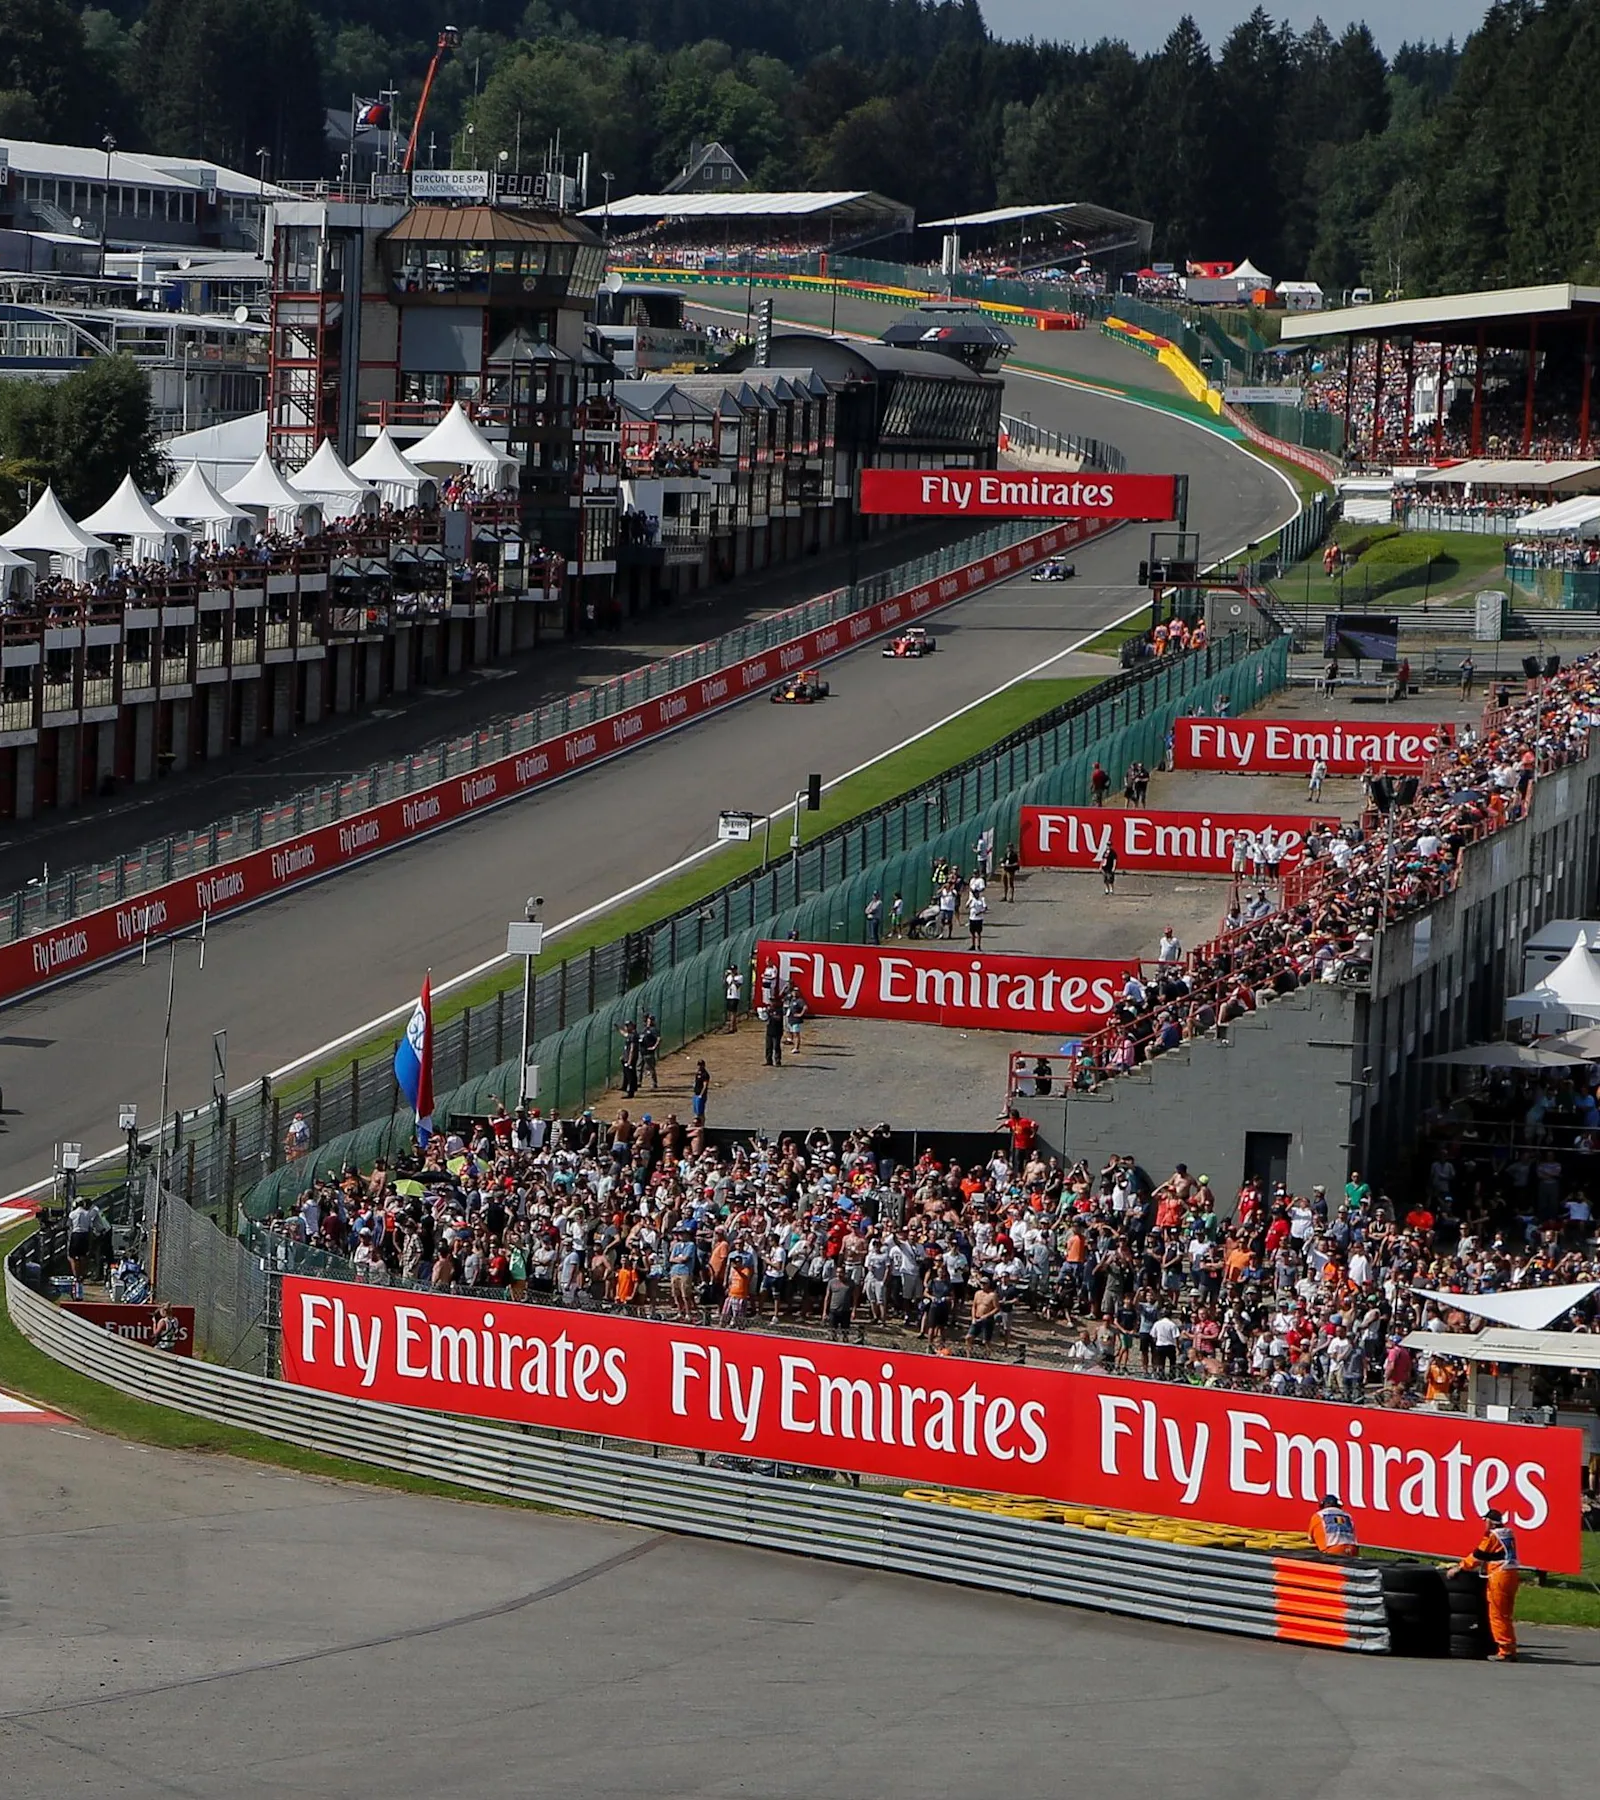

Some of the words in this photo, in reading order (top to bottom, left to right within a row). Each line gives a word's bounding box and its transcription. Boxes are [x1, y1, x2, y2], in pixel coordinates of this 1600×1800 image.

[1, 167, 6, 183] 6
[414, 174, 449, 184] CIRCUIT
[452, 174, 464, 184] DE
[466, 175, 485, 184] SPA
[414, 184, 486, 193] FRANCORCHAMPS
[921, 476, 972, 510] Fly
[979, 477, 1114, 507] Emirates
[1190, 724, 1255, 766] Fly
[1265, 725, 1440, 763] Emirates
[461, 781, 473, 807] Fly
[472, 774, 497, 799] Emirates
[402, 803, 415, 831] Fly
[414, 795, 441, 824] Emirates
[339, 828, 352, 855] Fly
[351, 818, 380, 848] Emirates
[1038, 814, 1112, 862] Fly
[271, 854, 286, 882] Fly
[285, 843, 316, 871] Emirates
[196, 881, 212, 911] Fly
[211, 870, 245, 902] Emirates
[116, 911, 131, 942] Fly
[33, 944, 50, 975] Fly
[50, 930, 88, 964] Emirates
[777, 951, 865, 1010] Fly
[878, 956, 1115, 1015] Emirates
[300, 1293, 383, 1388] Fly
[393, 1305, 628, 1406] Emirates
[670, 1341, 765, 1443] Fly
[779, 1354, 1048, 1465] Emirates
[1098, 1393, 1211, 1505] Fly
[1226, 1408, 1550, 1531] Emirates
